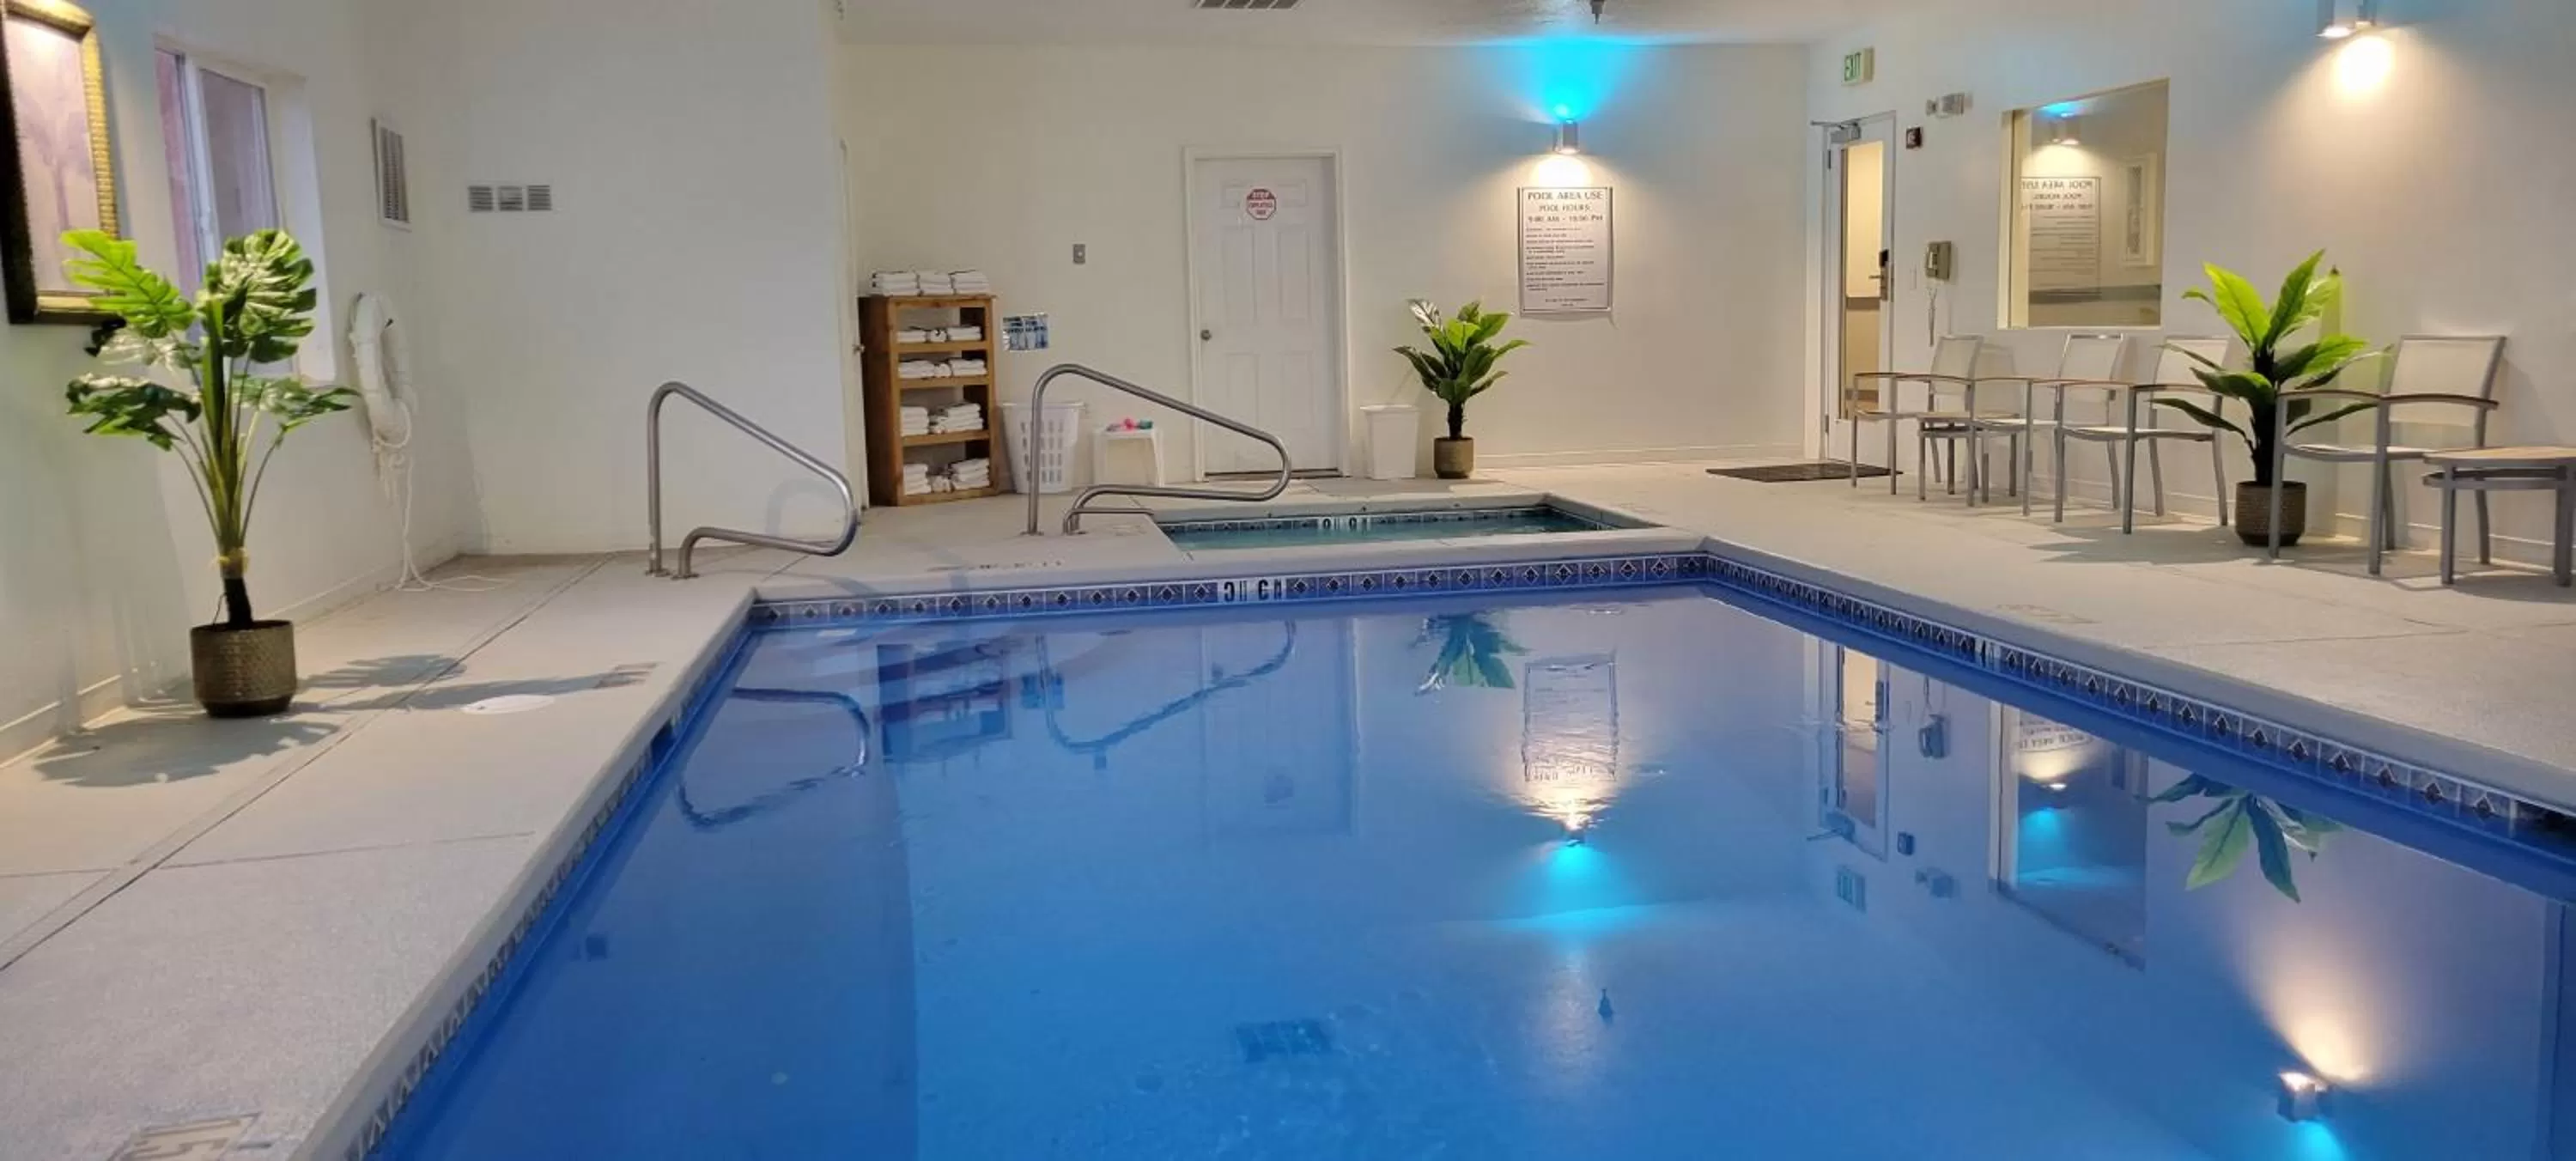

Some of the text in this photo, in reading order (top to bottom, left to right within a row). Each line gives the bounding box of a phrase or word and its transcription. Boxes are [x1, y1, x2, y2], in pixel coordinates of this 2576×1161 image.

[1844, 52, 1862, 82] EXIT
[1528, 191, 1603, 200] POOL AREA USE
